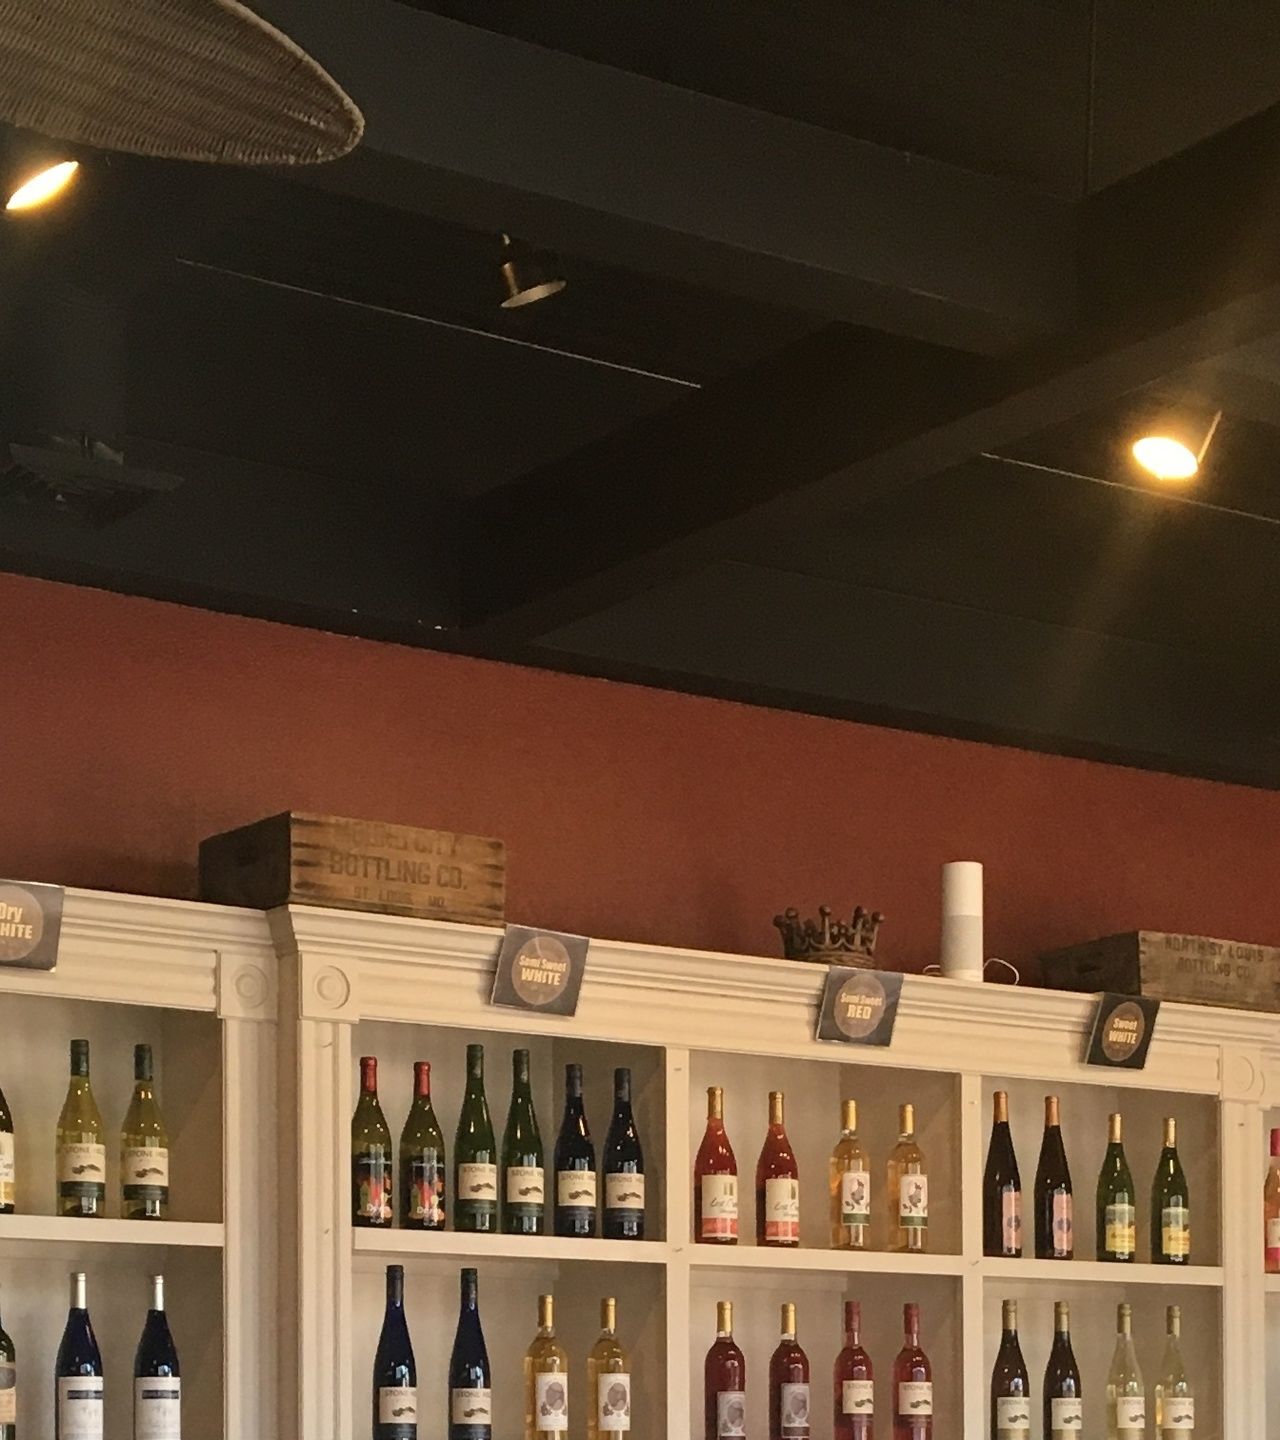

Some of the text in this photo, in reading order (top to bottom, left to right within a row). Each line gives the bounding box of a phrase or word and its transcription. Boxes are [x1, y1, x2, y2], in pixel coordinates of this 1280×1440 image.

[329, 852, 431, 885] BOTTLING
[521, 967, 561, 986] WHITE
[847, 1004, 872, 1020] RED
[1108, 1030, 1138, 1045] WHITE
